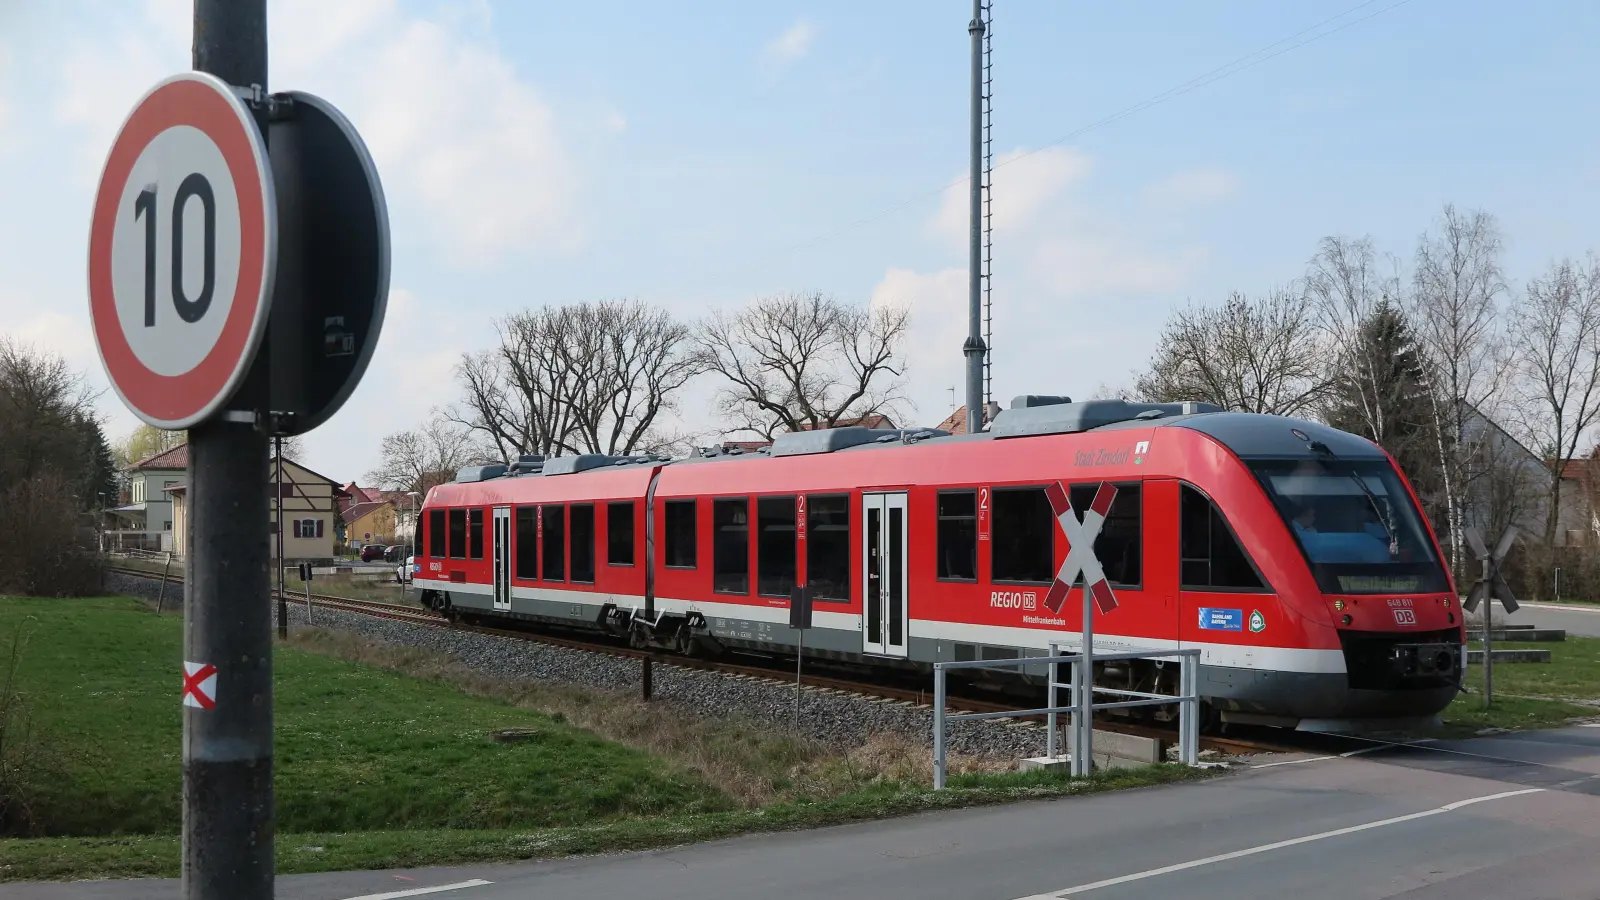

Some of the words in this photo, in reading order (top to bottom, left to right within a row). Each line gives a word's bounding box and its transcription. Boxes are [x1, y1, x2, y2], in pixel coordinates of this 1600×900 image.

[134, 172, 216, 328] 10
[798, 495, 804, 513] 2
[980, 488, 988, 509] 2
[990, 591, 1021, 609] REGIO
[1024, 593, 1035, 610] DB
[1022, 615, 1066, 626] Mittelfrankenbahn
[1395, 610, 1414, 623] DB
